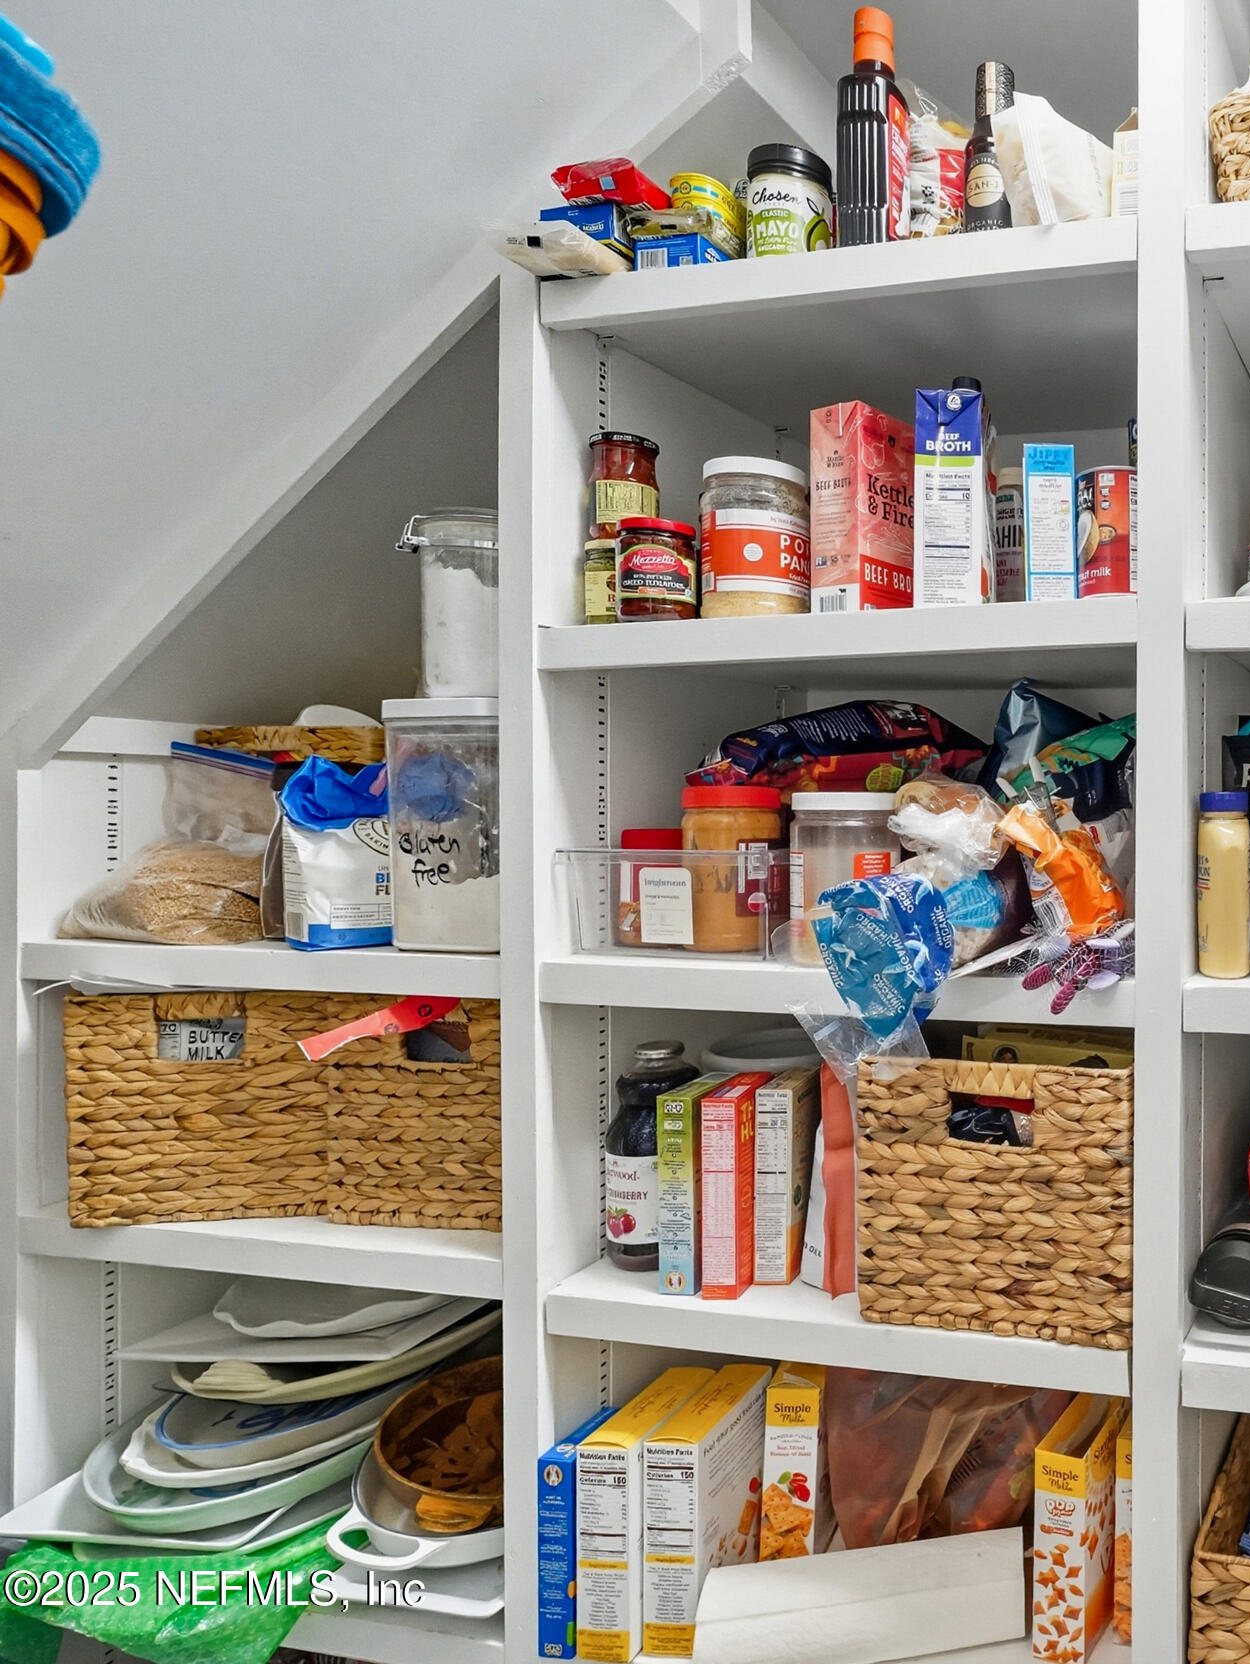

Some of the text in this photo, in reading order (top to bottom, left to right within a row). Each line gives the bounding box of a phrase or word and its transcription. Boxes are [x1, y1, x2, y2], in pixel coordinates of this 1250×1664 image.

[752, 187, 802, 205] Chosen
[756, 220, 799, 239] MAYO
[925, 440, 971, 452] BROTH
[867, 473, 914, 509] Kettle
[868, 495, 914, 528] & Fire
[864, 562, 888, 586] BEEF
[1090, 566, 1111, 577] milk
[399, 832, 461, 857] Gluten
[411, 859, 451, 888] free
[933, 905, 952, 949] ORGANIC
[188, 1046, 226, 1061] MILK
[774, 1403, 811, 1415] Simple
[579, 1452, 606, 1461] Nutrition
[647, 1448, 674, 1456] Nutrition
[1041, 1464, 1079, 1482] Simple
